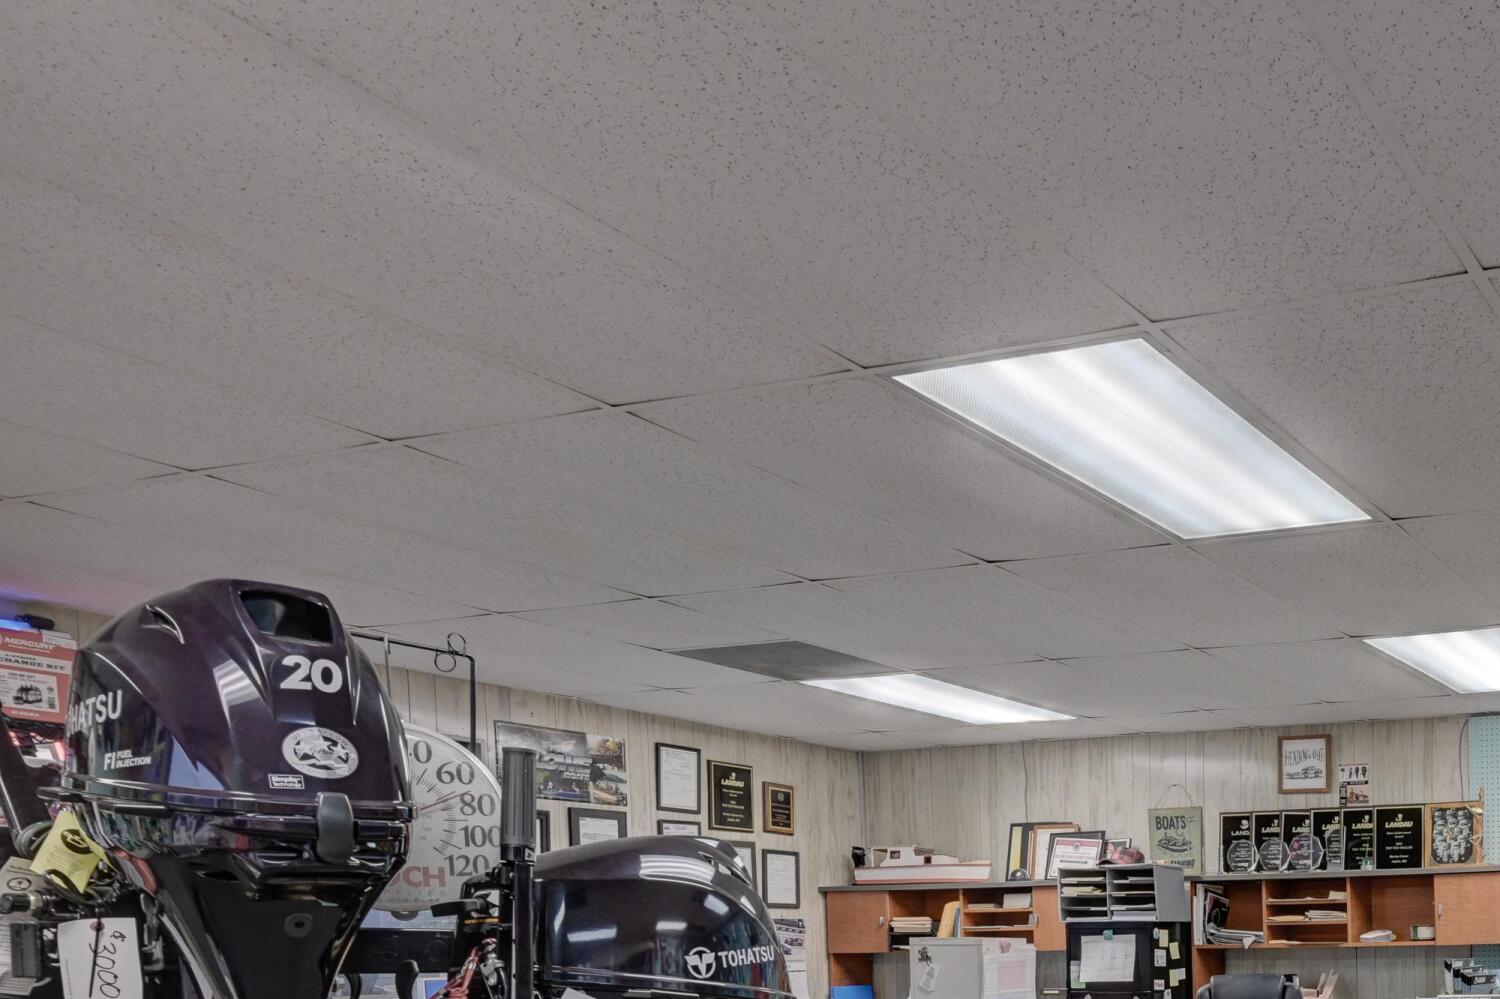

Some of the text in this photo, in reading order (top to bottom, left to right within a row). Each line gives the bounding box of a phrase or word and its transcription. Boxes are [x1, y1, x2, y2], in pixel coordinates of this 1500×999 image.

[280, 654, 343, 693] 20
[67, 689, 122, 736] HATSU
[115, 756, 151, 768] INJECTION
[116, 749, 132, 758] FUEL
[536, 752, 592, 773] OWE
[436, 761, 475, 785] 60
[459, 793, 495, 816] 80
[1155, 815, 1187, 831] BOATS
[1384, 820, 1413, 829] LANDAU
[459, 825, 500, 848] 100
[444, 854, 490, 877] 120
[718, 946, 774, 968] TOHATSU
